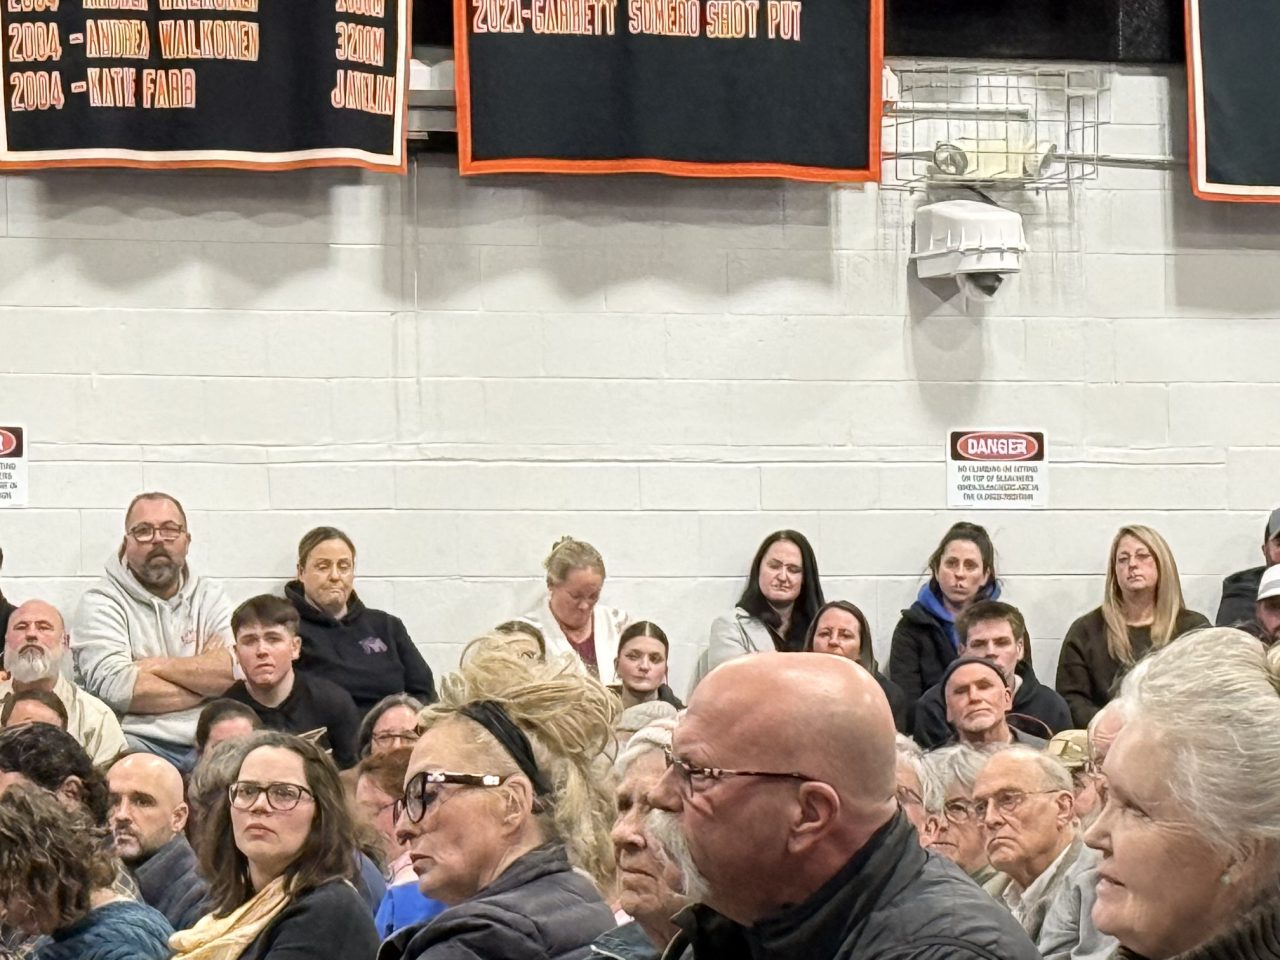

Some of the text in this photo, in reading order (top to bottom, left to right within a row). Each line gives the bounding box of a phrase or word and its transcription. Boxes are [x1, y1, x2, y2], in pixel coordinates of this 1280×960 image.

[8, 22, 62, 62] 2004
[159, 20, 260, 61] WALKONEN
[706, 0, 759, 38] SHOT
[768, 1, 802, 41] PUT
[335, 22, 385, 67] 3200M
[10, 71, 65, 111] 2004
[331, 69, 395, 115] JAVELIN
[967, 438, 1027, 455] DANGER
